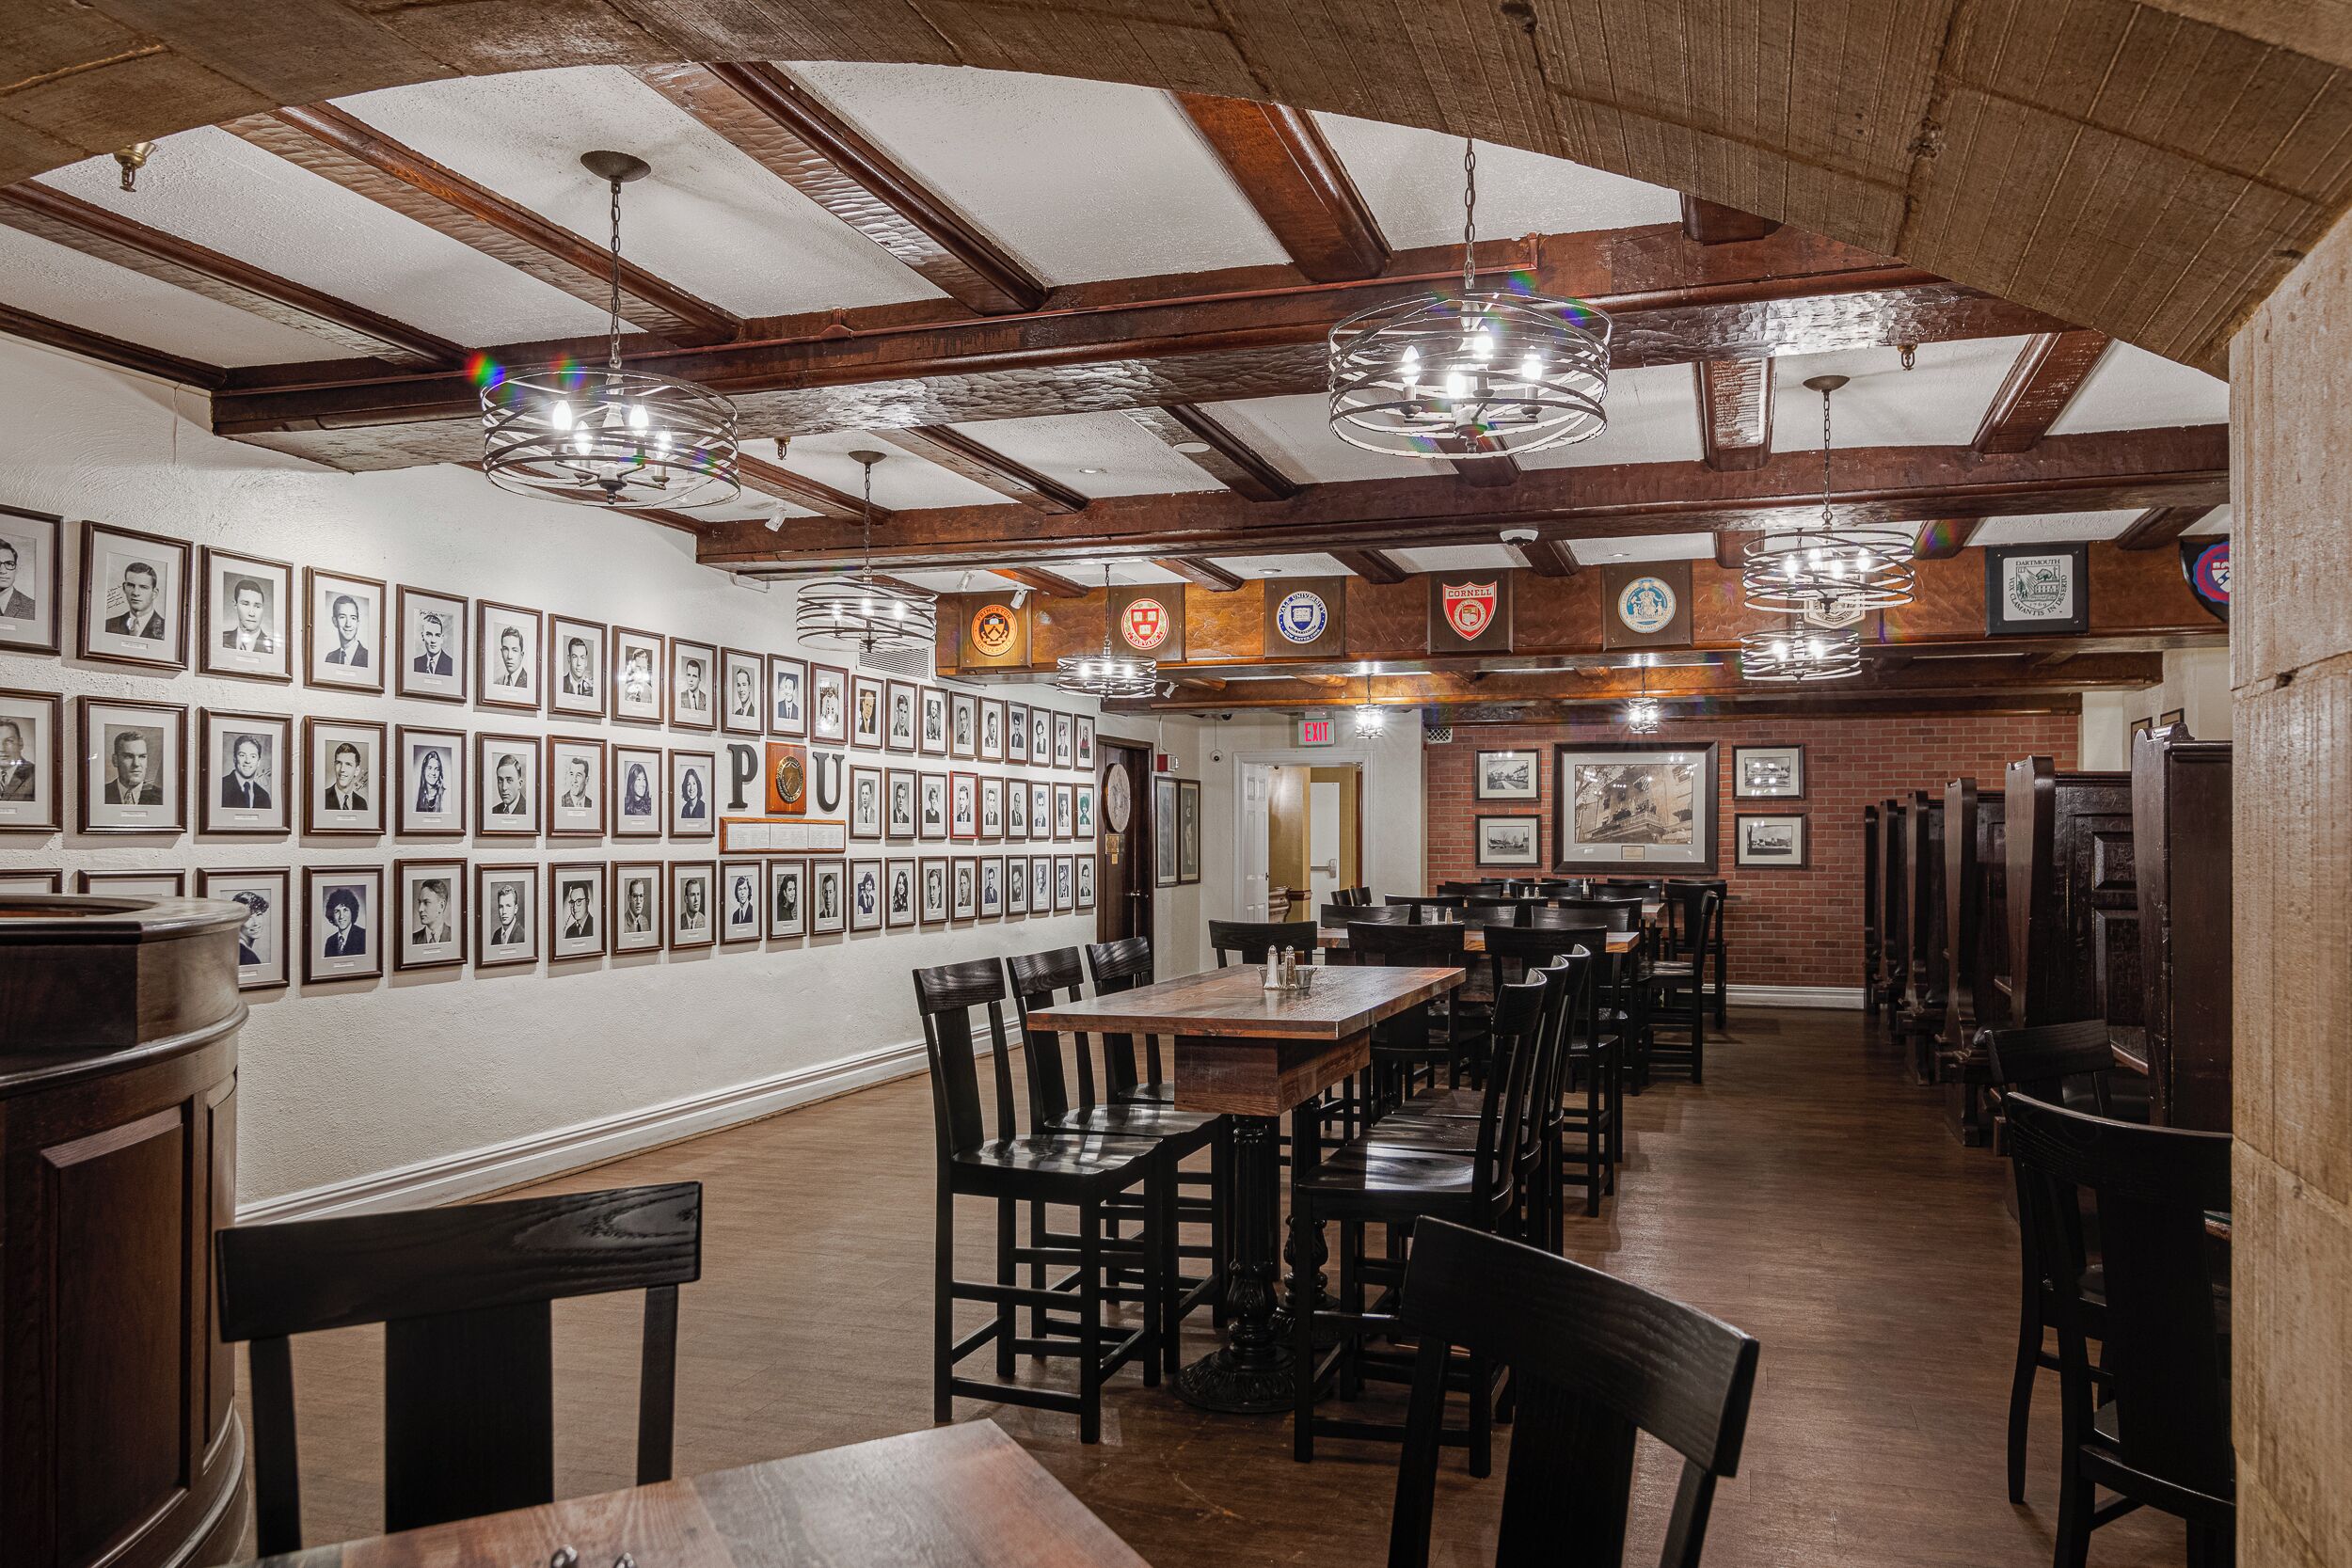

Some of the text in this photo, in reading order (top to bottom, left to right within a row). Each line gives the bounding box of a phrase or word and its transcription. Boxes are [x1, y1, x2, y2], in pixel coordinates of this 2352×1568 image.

[1448, 588, 1492, 597] CORNELL
[2010, 593, 2044, 616] CLAMANTIS
[2047, 605, 2057, 614] IN
[2055, 575, 2068, 607] DESERTO
[977, 607, 1012, 621] PRINCETON
[1279, 593, 1327, 616] YALE UNIVERSITY
[1304, 721, 1329, 742] EXIT
[727, 743, 758, 809] P
[812, 751, 845, 812] U
